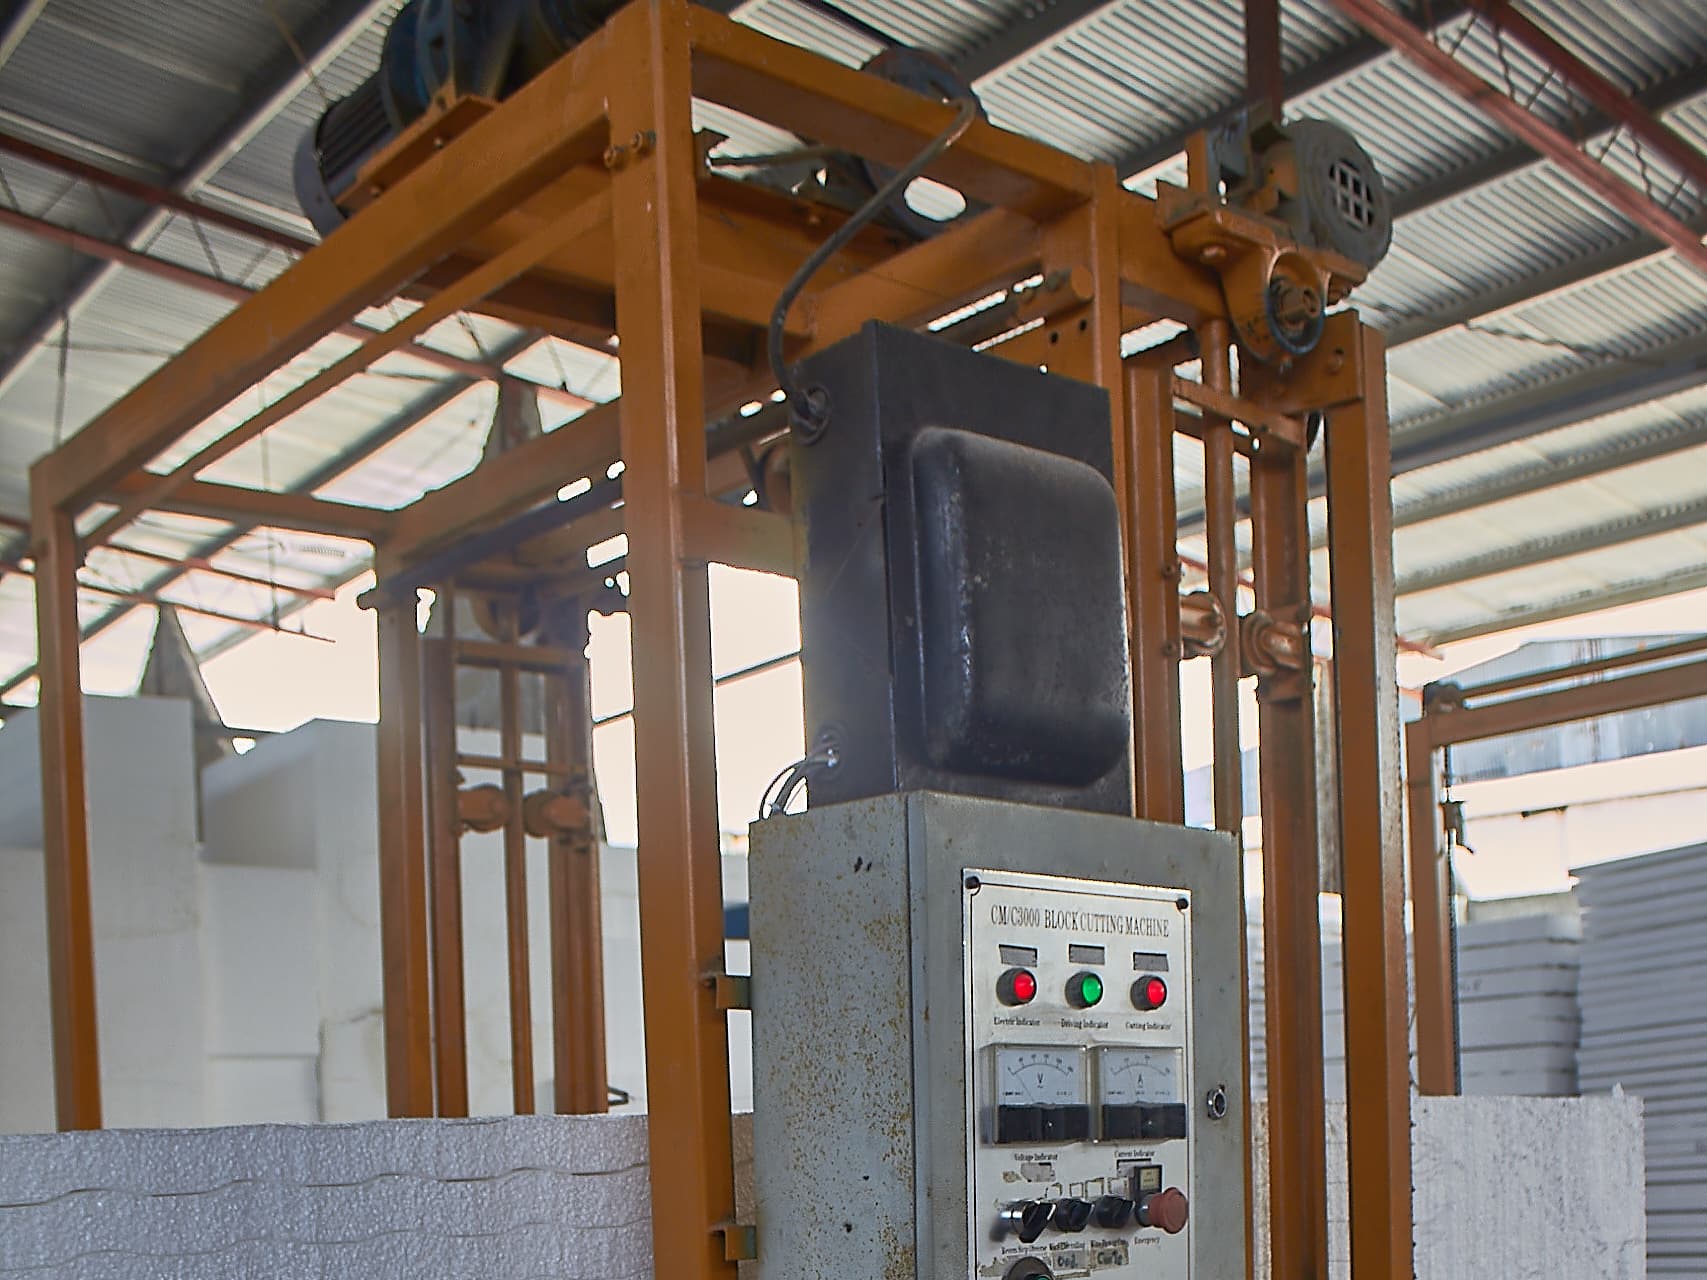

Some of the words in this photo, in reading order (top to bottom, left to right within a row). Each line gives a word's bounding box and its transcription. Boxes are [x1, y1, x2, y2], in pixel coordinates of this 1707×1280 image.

[1044, 909, 1079, 931] BLOCK
[1080, 912, 1124, 934] CUTTING
[1125, 916, 1170, 938] MACHINE
[1016, 1016, 1040, 1026] Indicator
[1083, 1019, 1109, 1030] Indicator
[1147, 1021, 1172, 1031] Indicator
[1034, 1152, 1058, 1161] Indicator
[1133, 1149, 1155, 1157] Indicator
